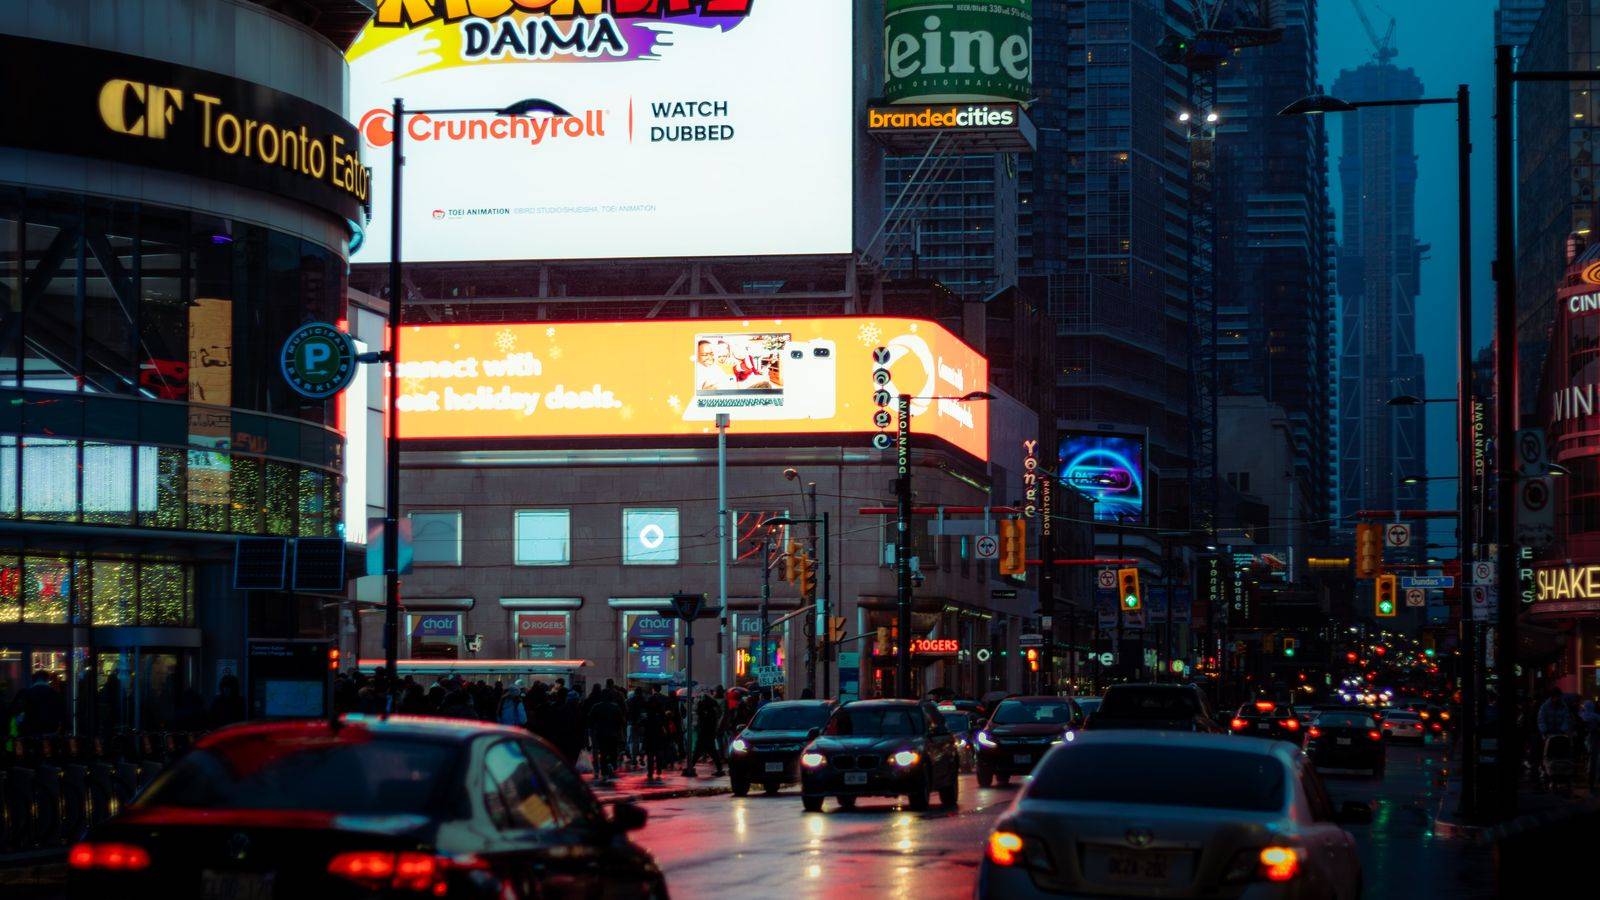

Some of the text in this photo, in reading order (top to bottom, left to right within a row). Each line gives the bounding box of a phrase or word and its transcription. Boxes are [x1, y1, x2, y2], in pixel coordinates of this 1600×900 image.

[465, 18, 624, 56] DAIMA
[884, 15, 1033, 84] eine
[651, 101, 729, 118] WATCH
[868, 106, 1014, 128] brandedcities
[98, 78, 184, 139] CF
[193, 93, 325, 178] Toronto
[407, 109, 606, 145] Crunchyroll
[651, 124, 735, 142] DUBBED
[466, 207, 510, 216] ANIMATION
[618, 204, 657, 212] ANIMATION
[287, 327, 346, 355] MUNICIPAL
[304, 342, 331, 370] P
[483, 352, 542, 377] with
[443, 385, 541, 416] holiday
[545, 384, 623, 409] deals.
[873, 346, 892, 451] Yonge
[899, 400, 908, 474] DOWNTOWN
[1474, 402, 1484, 476] DOWNTOWN
[1023, 439, 1038, 518] Yonge
[1043, 480, 1051, 536] DOWNTOWN
[1411, 577, 1439, 586] Dundas
[1537, 565, 1600, 601] SHAKE
[422, 617, 456, 629] chatr
[531, 621, 564, 629] ROGERS
[639, 617, 672, 629] chatr
[916, 639, 959, 651] ROGERS
[641, 655, 660, 667] $15
